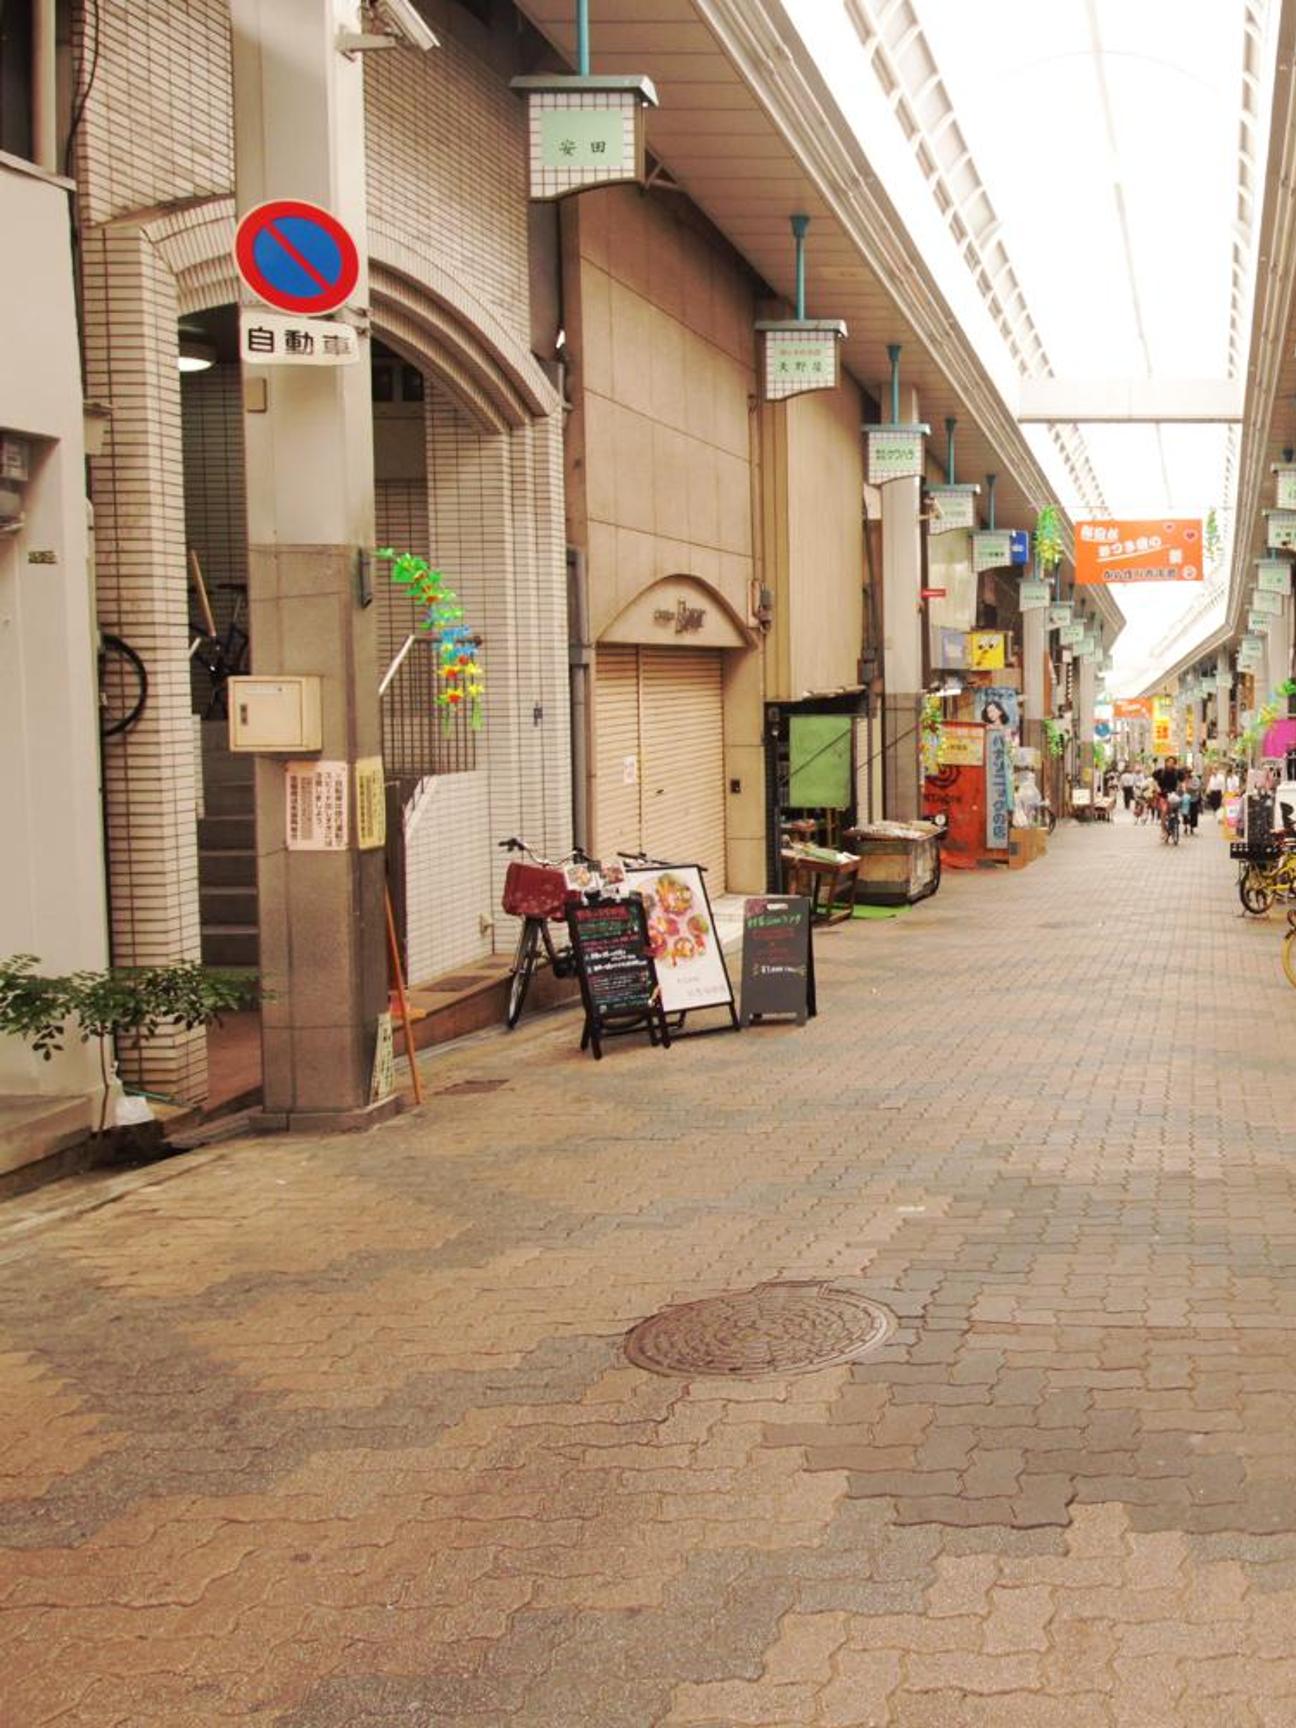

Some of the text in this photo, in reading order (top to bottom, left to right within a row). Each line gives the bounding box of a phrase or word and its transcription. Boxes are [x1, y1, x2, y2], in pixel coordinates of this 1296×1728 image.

[558, 139, 607, 157] 安田
[247, 326, 352, 355] 自動車
